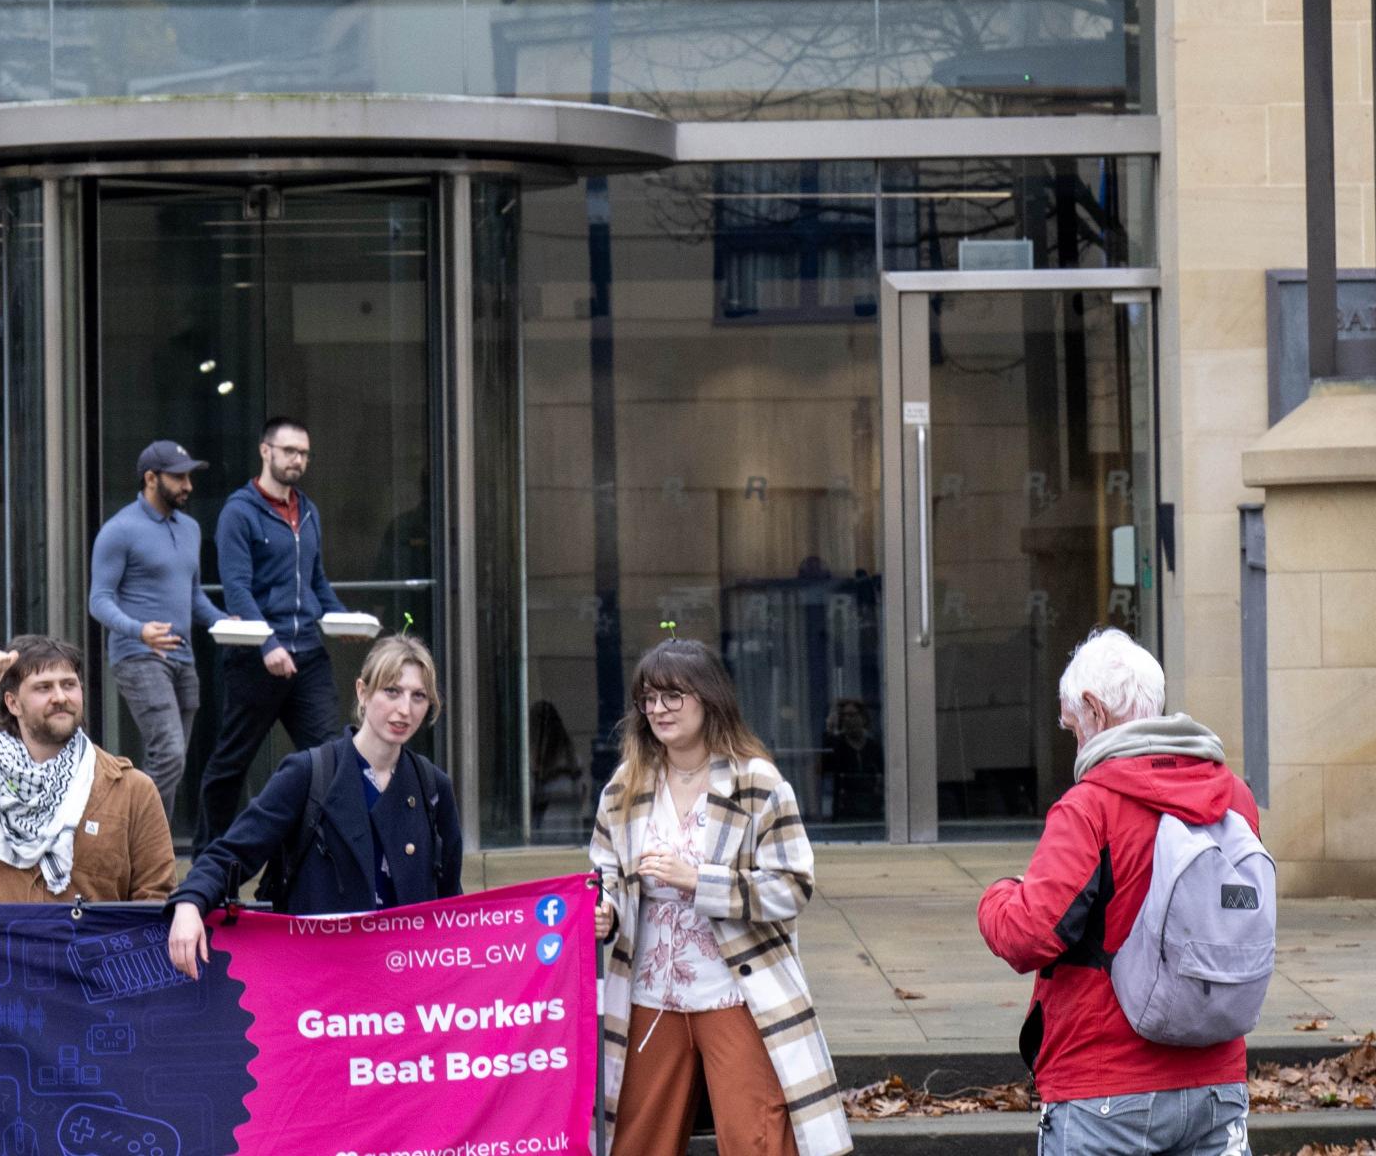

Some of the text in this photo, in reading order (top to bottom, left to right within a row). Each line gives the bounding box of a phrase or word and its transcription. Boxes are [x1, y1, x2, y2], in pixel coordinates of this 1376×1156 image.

[289, 917, 352, 936] IWGB
[361, 915, 425, 933] Game
[432, 907, 524, 929] Workers
[385, 943, 527, 973] @IWGB_GW
[296, 998, 565, 1039] Game Workers
[349, 1046, 569, 1086] Beat Bosses
[364, 1132, 570, 1156] workers.co.uk
